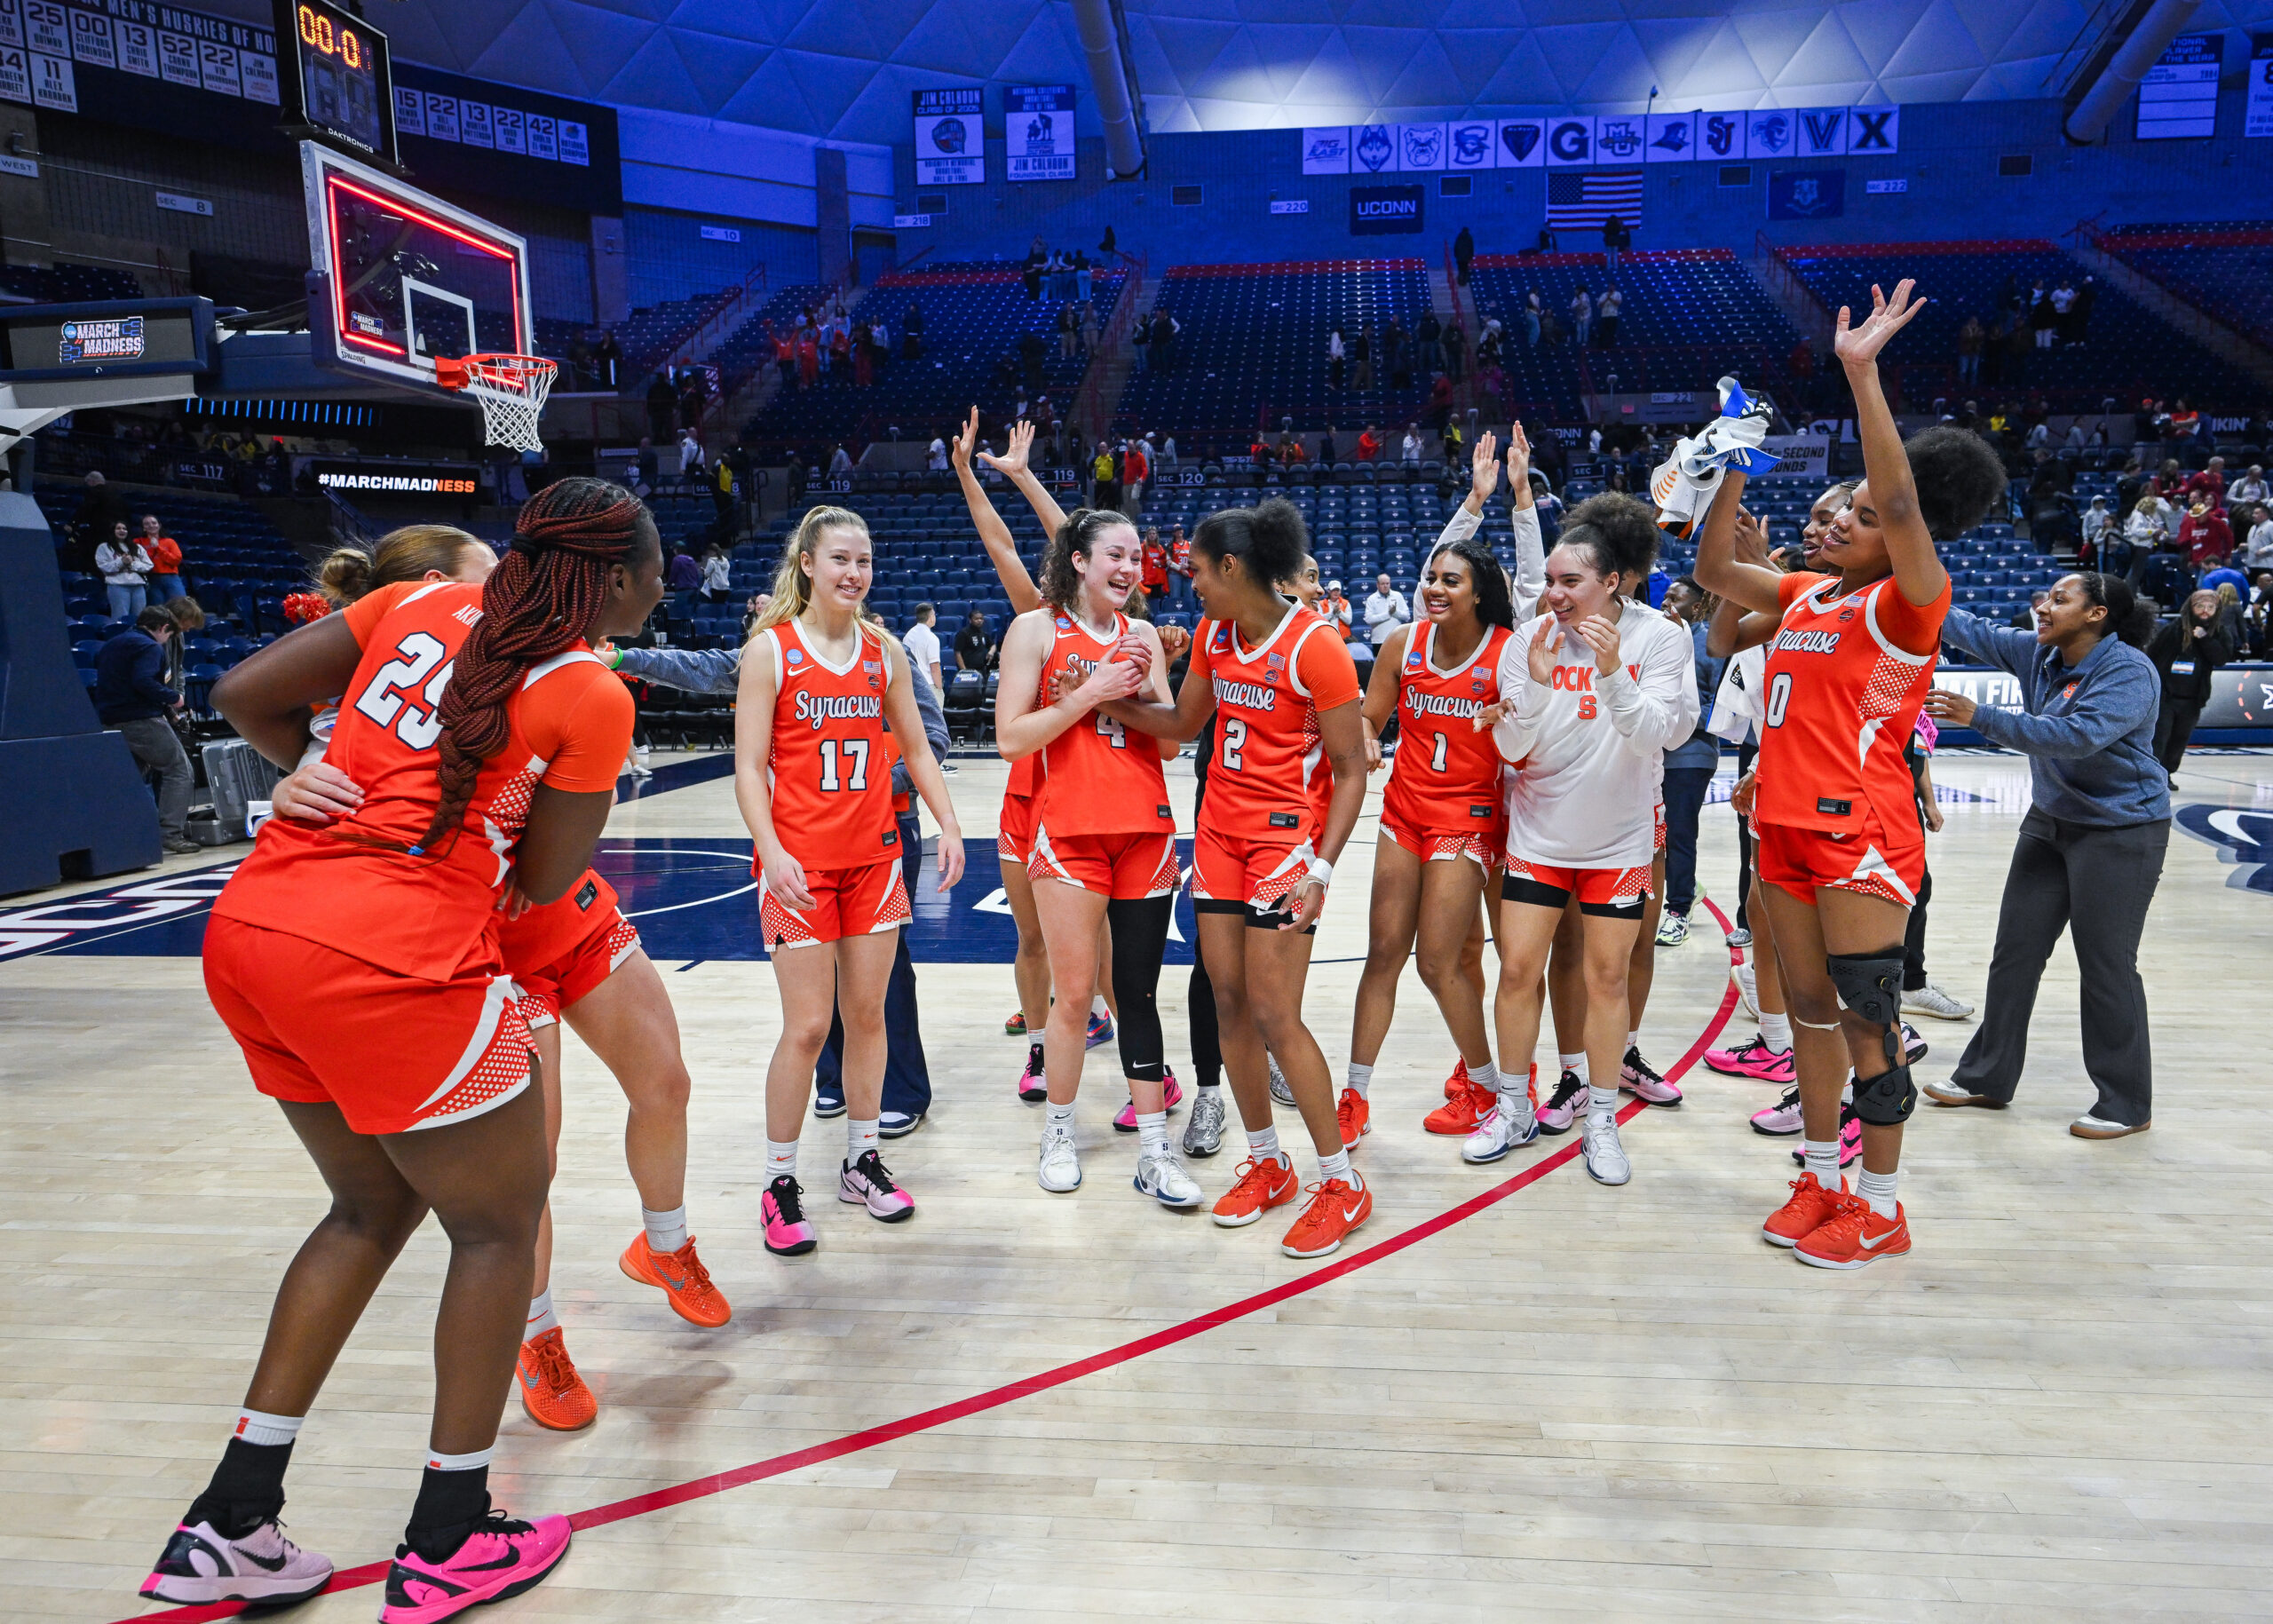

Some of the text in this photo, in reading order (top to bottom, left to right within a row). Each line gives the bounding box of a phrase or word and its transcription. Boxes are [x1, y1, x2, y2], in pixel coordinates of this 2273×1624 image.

[28, 2, 63, 26] 25
[75, 12, 107, 36] 00
[107, 0, 278, 54] MEN'S HUSKIES OF HO
[123, 25, 147, 46] 13
[2173, 37, 2208, 46] TIONAL
[162, 34, 193, 58] 52
[203, 44, 234, 67] 22
[44, 59, 61, 80] 11
[398, 90, 417, 108] 15
[429, 97, 455, 115] 22
[920, 90, 980, 106] JIM CALHOUN
[467, 104, 486, 122] 13
[496, 110, 521, 129] 22
[917, 106, 943, 115] CLASS
[531, 117, 554, 135] 42
[1802, 111, 1845, 153] V
[1849, 111, 1897, 150] X
[328, 127, 374, 154] DAKTRONICS
[1550, 122, 1590, 162] G
[1307, 146, 1348, 157] EAST
[1, 160, 33, 171] WEST
[1014, 157, 1068, 170] JIM CALHOUN
[1883, 180, 1906, 191] 222
[158, 196, 206, 212] SEC 8
[1286, 202, 1308, 211] 220
[1357, 200, 1416, 215] UCONN
[913, 216, 929, 226] 218
[724, 230, 738, 241] 10
[357, 314, 375, 326] MARCH
[360, 322, 383, 336] MADNESS
[76, 322, 120, 339] MARCH
[83, 337, 142, 354] MADNESS
[341, 351, 366, 364] SPALDING
[1783, 447, 1826, 458] SECOND
[180, 463, 224, 479] SEC 117
[1054, 470, 1075, 480] 119
[1769, 461, 1807, 472] UNDS
[318, 473, 475, 494] #MARCHMADNESS
[830, 479, 851, 491] 119
[1179, 473, 1204, 484] 120
[1551, 665, 1594, 692] OCK
[1211, 669, 1276, 711] Syracuse
[2063, 681, 2082, 699] S
[1405, 685, 1484, 720] Syracuse
[1578, 695, 1597, 719] S
[1766, 672, 1793, 728] 0
[796, 690, 881, 730] Syracuse
[1096, 711, 1126, 749] 4
[1223, 717, 1247, 772] 2
[1430, 732, 1448, 772] 1
[820, 739, 869, 792] 17
